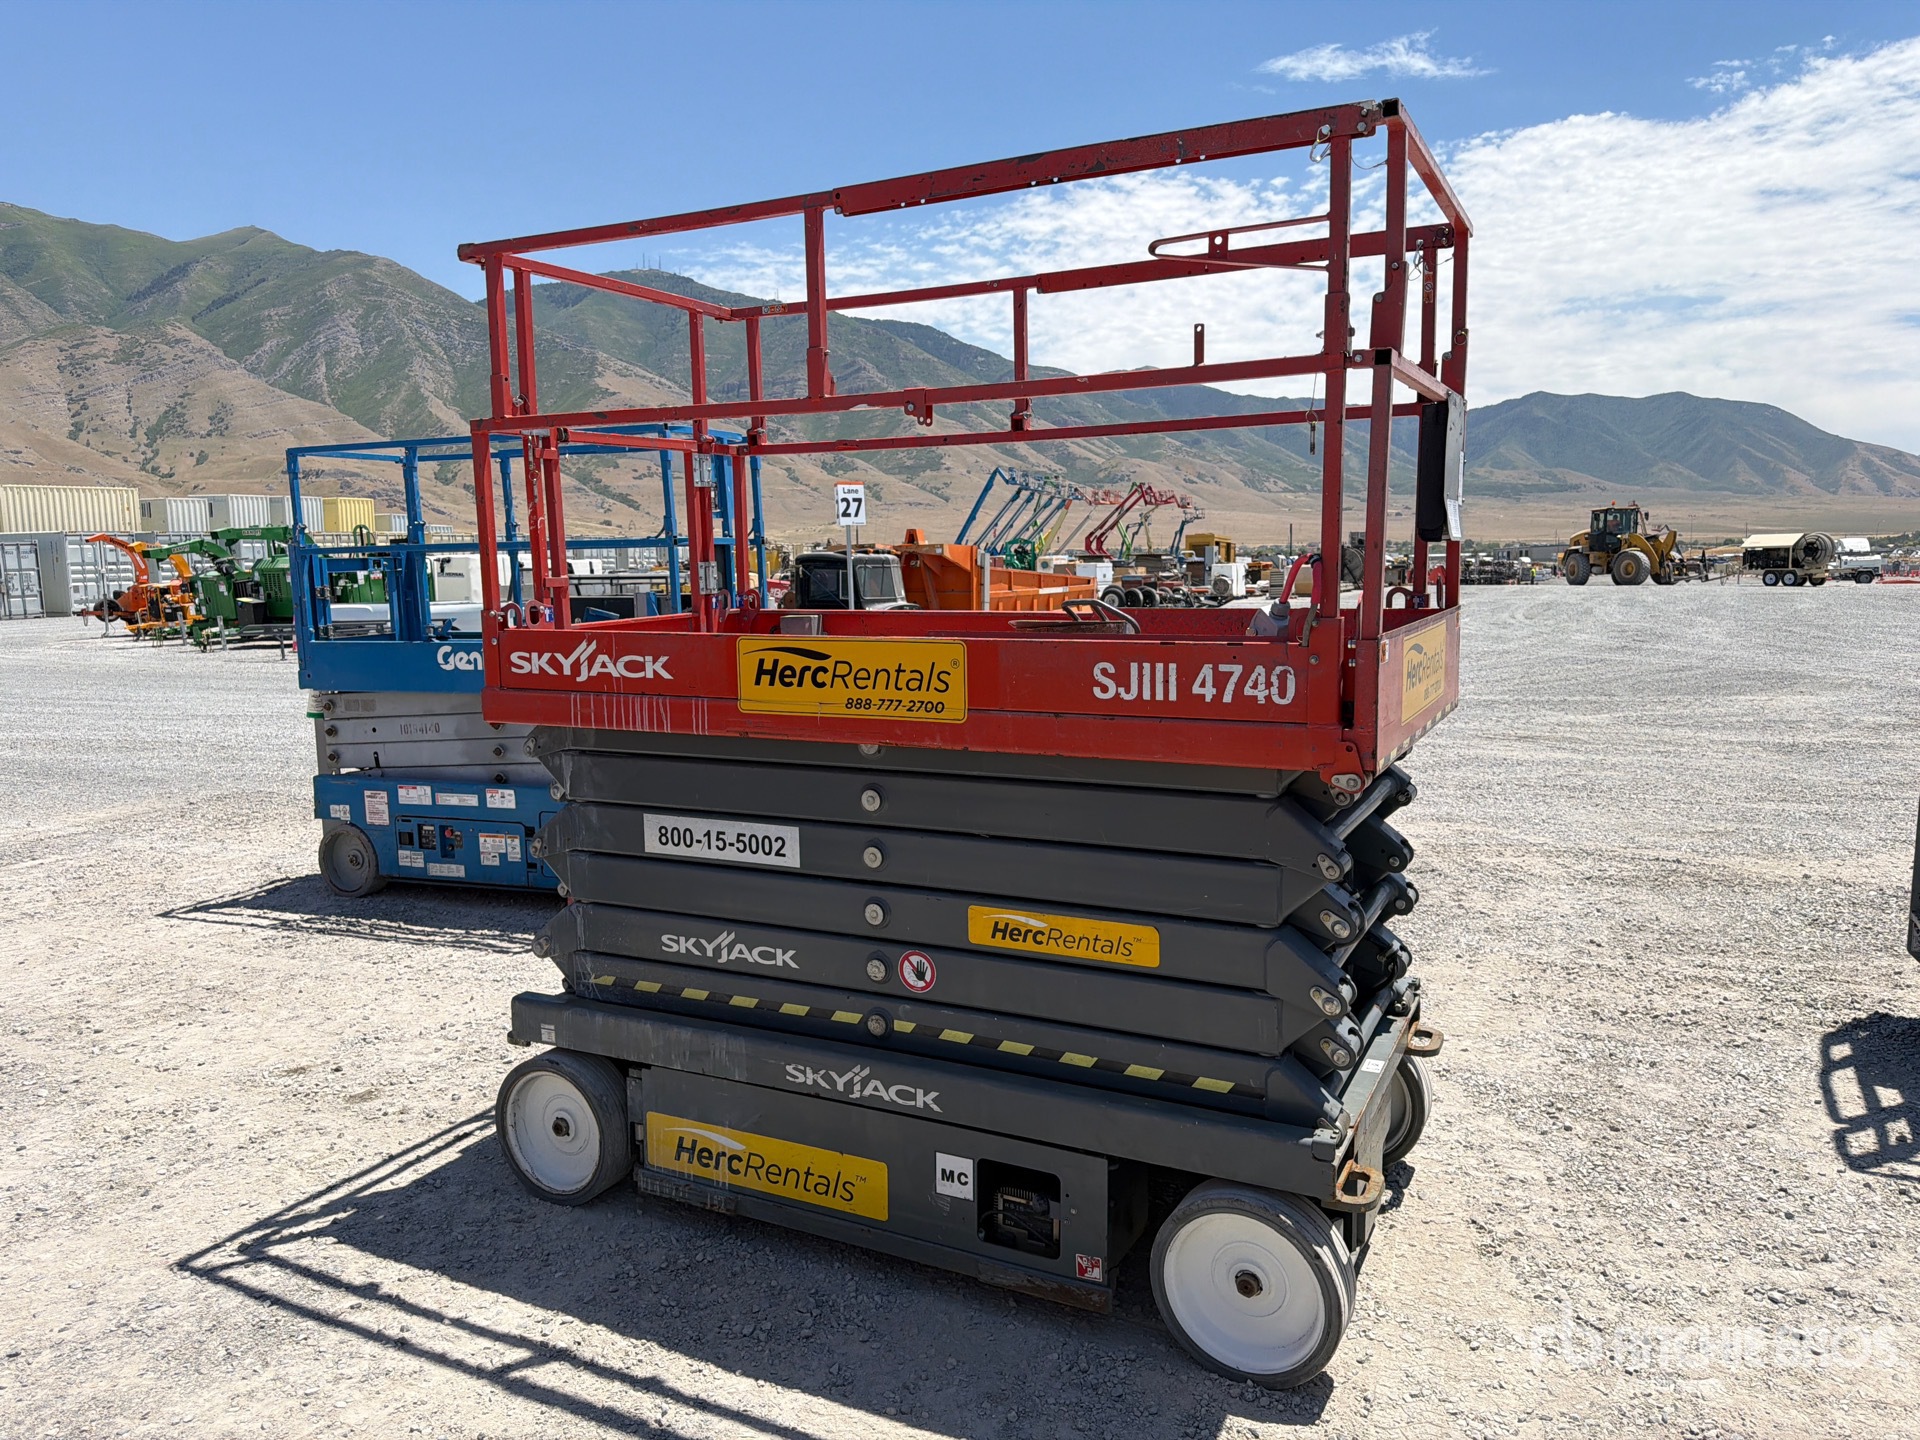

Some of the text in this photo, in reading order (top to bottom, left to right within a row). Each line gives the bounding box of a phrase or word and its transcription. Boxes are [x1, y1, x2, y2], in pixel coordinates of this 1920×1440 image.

[842, 487, 859, 495] Lane
[840, 497, 863, 518] 27
[436, 645, 485, 671] Gen
[510, 638, 673, 683] SKYJACK
[1092, 660, 1296, 706] SJIII 4740
[844, 697, 945, 715] 888-777-2700
[657, 825, 787, 859] 800-15-5002
[660, 930, 801, 970] SKYJACK
[783, 1063, 944, 1113] SKYJACK
[940, 1167, 970, 1187] MC
